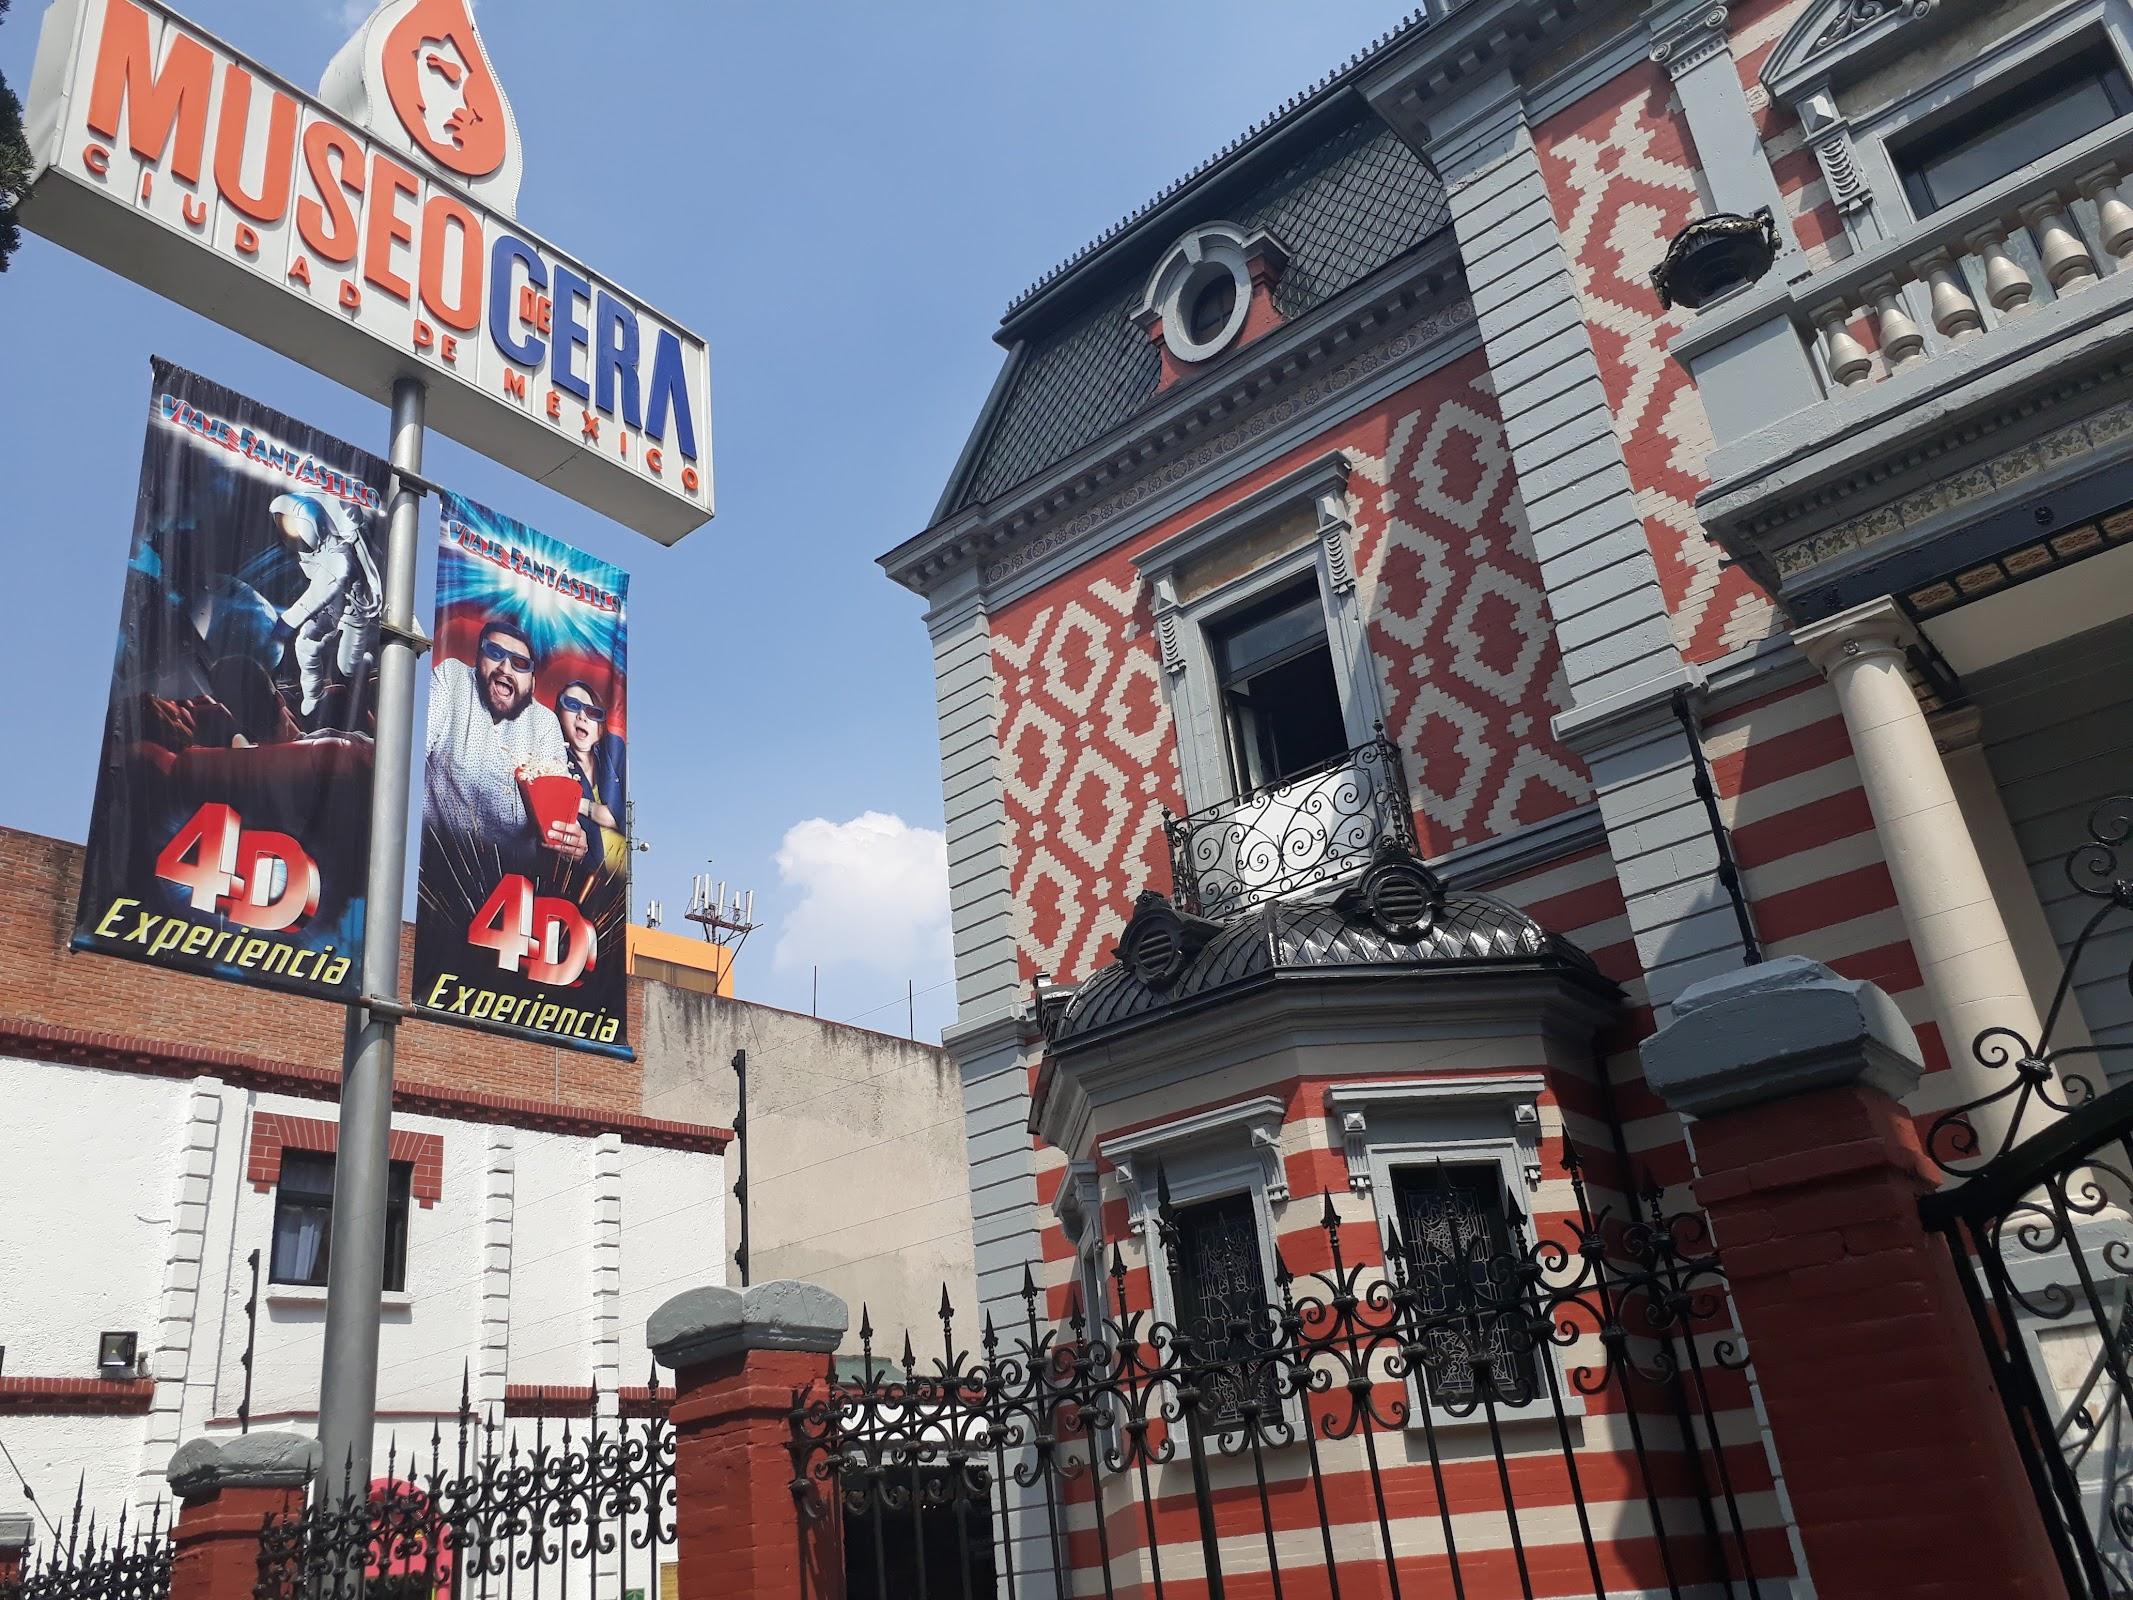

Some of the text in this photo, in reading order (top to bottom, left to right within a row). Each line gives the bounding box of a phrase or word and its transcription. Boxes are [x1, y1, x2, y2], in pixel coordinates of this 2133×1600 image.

[87, 0, 697, 461] MUSEO CERA
[82, 144, 699, 491] CIUDAD DE MÉXICO
[161, 393, 382, 511] VIAJE FANTÁSTICO
[448, 520, 622, 614] VIAJE FANTÁSTICO
[155, 801, 321, 933] 4D
[94, 897, 351, 985] Experiencia
[467, 873, 598, 988] 4D
[426, 973, 620, 1043] Experiencia
